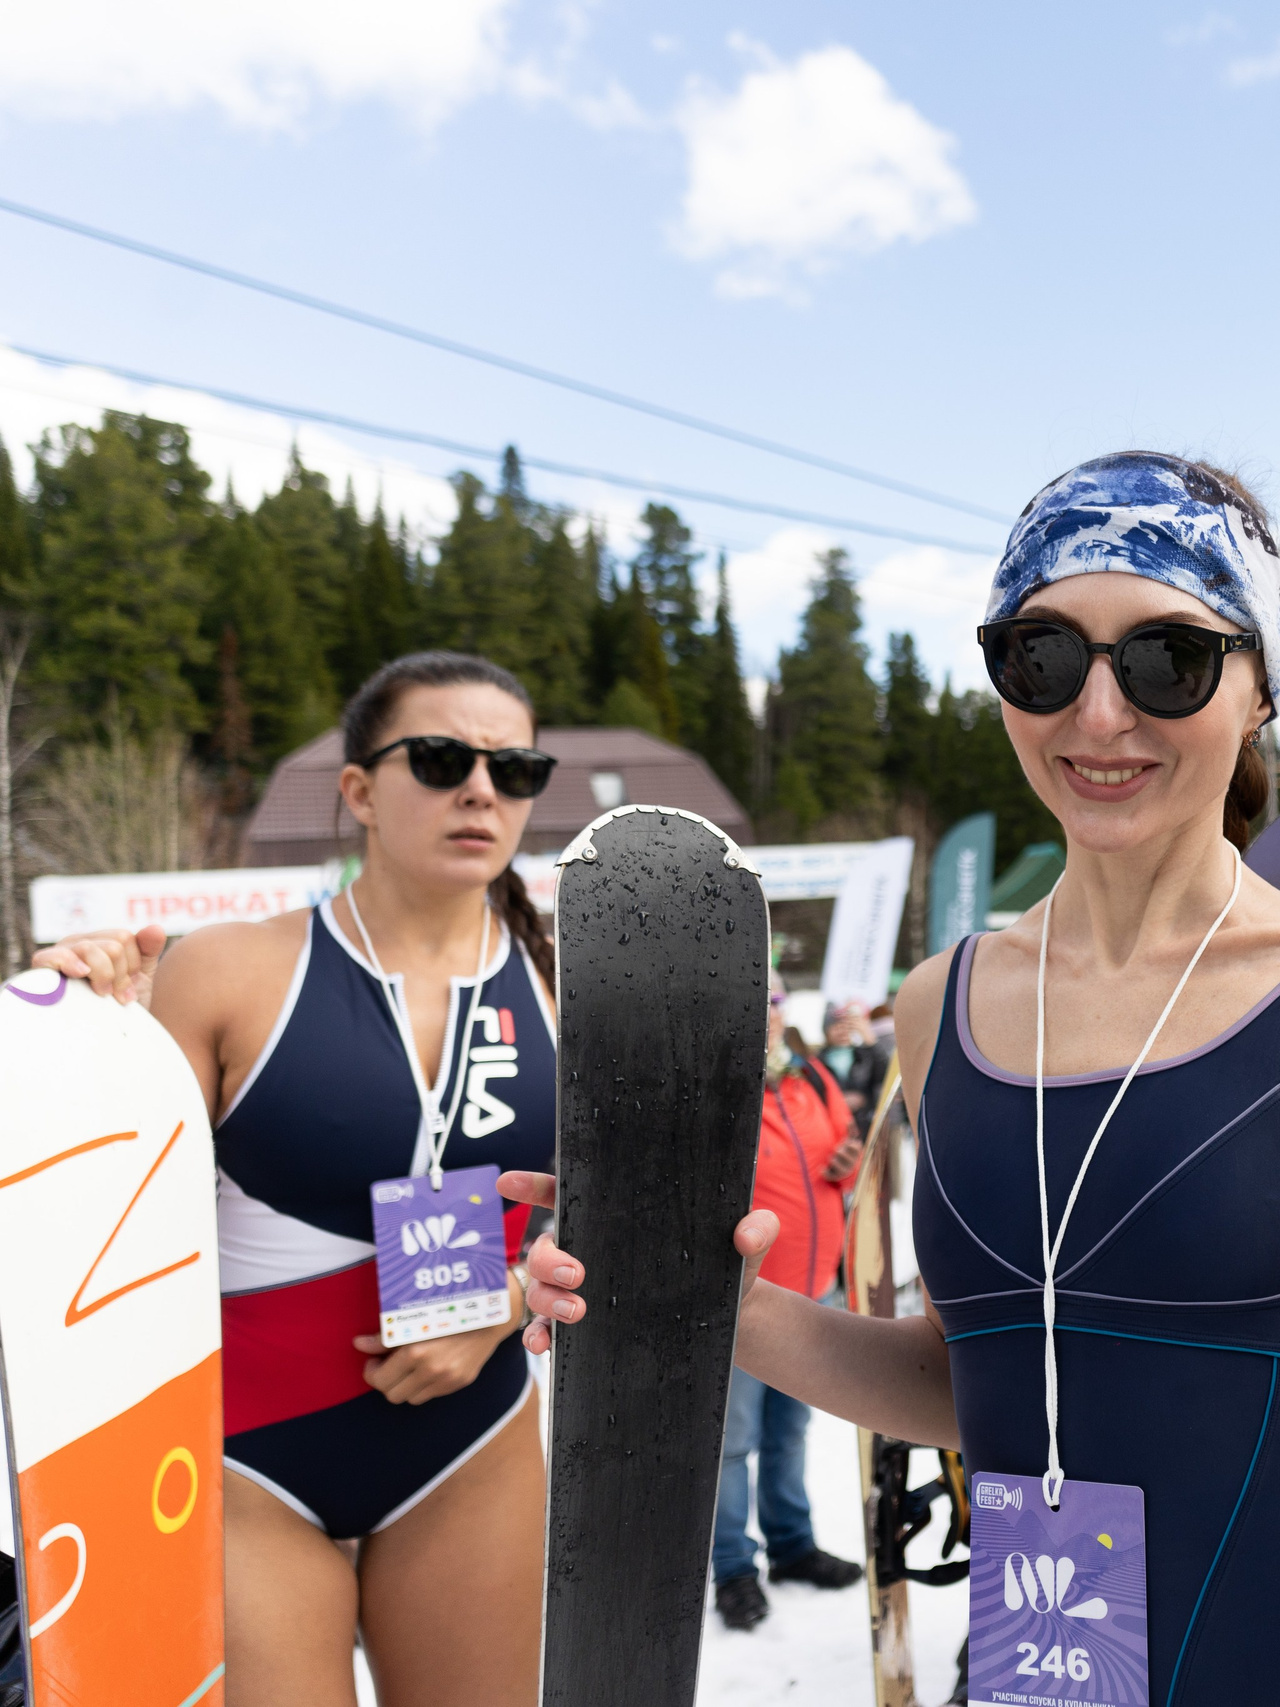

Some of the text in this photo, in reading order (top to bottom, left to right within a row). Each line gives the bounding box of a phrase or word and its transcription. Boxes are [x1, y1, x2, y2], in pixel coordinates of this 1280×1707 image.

[127, 889, 290, 921] ПРОКАТ
[462, 1005, 519, 1139] FILA
[414, 1261, 471, 1290] 805
[980, 1485, 1003, 1497] GRELKA
[980, 1495, 996, 1506] FEST
[1016, 1642, 1091, 1682] 246
[992, 1691, 1116, 1707] УЧАСТНИК СПУСКА В КУПАЛЬН
